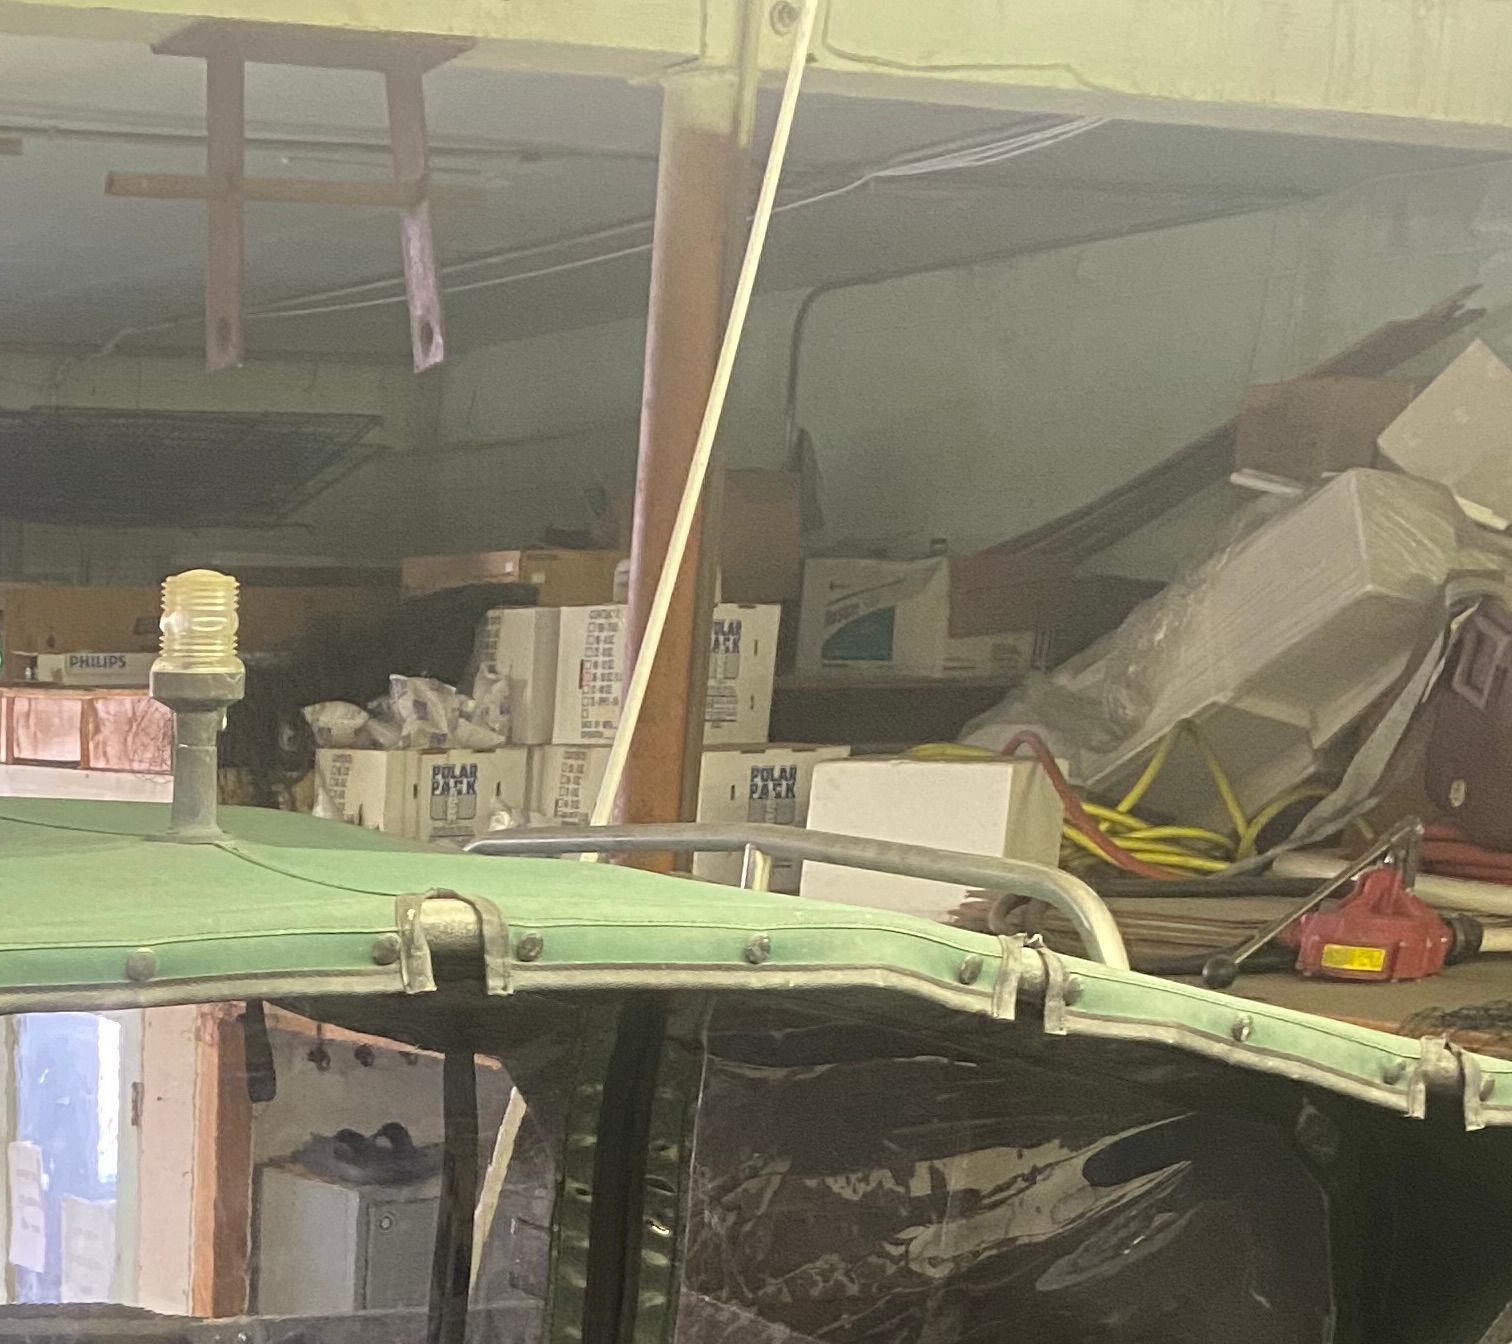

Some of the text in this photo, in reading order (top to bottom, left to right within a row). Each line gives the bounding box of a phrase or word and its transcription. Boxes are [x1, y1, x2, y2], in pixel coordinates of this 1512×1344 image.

[69, 654, 127, 669] PHILIPS
[432, 763, 478, 780] POLAR
[751, 764, 798, 782] POLAR
[431, 779, 477, 796] PACK
[749, 782, 796, 800] PACK
